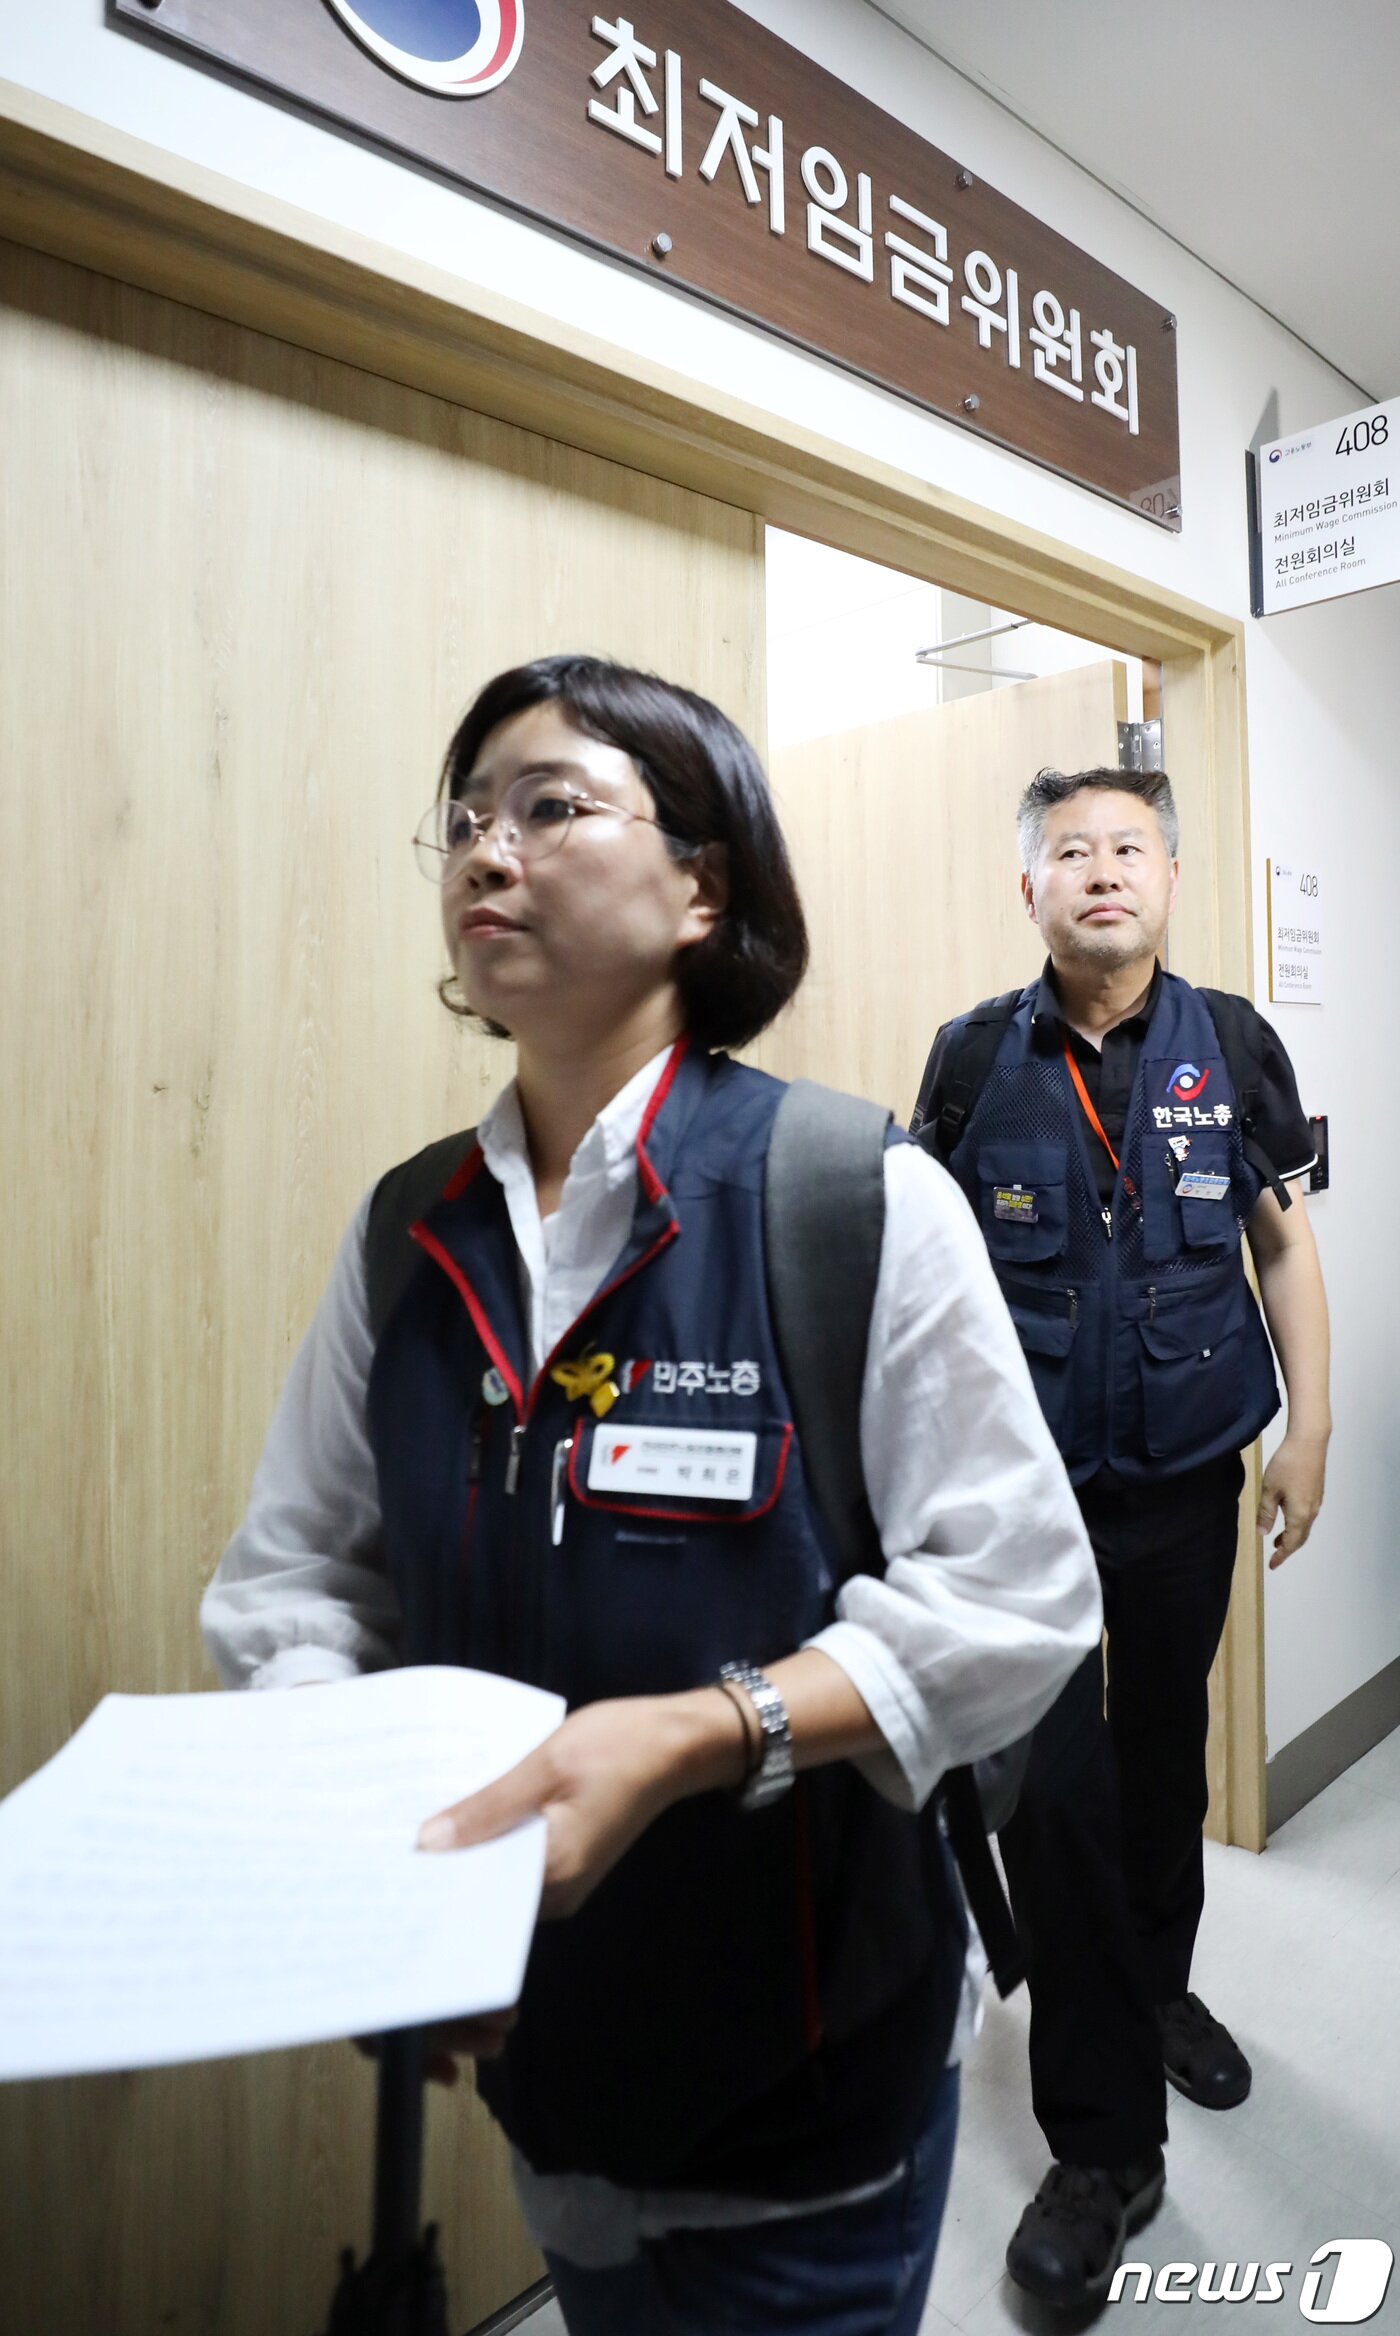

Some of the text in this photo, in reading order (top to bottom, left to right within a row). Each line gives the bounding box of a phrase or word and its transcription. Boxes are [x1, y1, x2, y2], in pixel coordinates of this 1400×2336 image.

[588, 15, 1139, 435] 최저임금위원회
[1335, 414, 1389, 456] 408
[1273, 477, 1389, 528] 최저임금위원회
[1274, 500, 1398, 543] Minimum Wage Commission
[1275, 535, 1356, 575] 전원회의실
[1275, 558, 1366, 589] All Conference Room
[1299, 873, 1319, 898] 408
[1278, 926, 1320, 945] 최저임금위원회
[1278, 963, 1309, 980] 전원회의실
[1152, 1103, 1233, 1129] 한국노총
[652, 1358, 760, 1396] 민주노총
